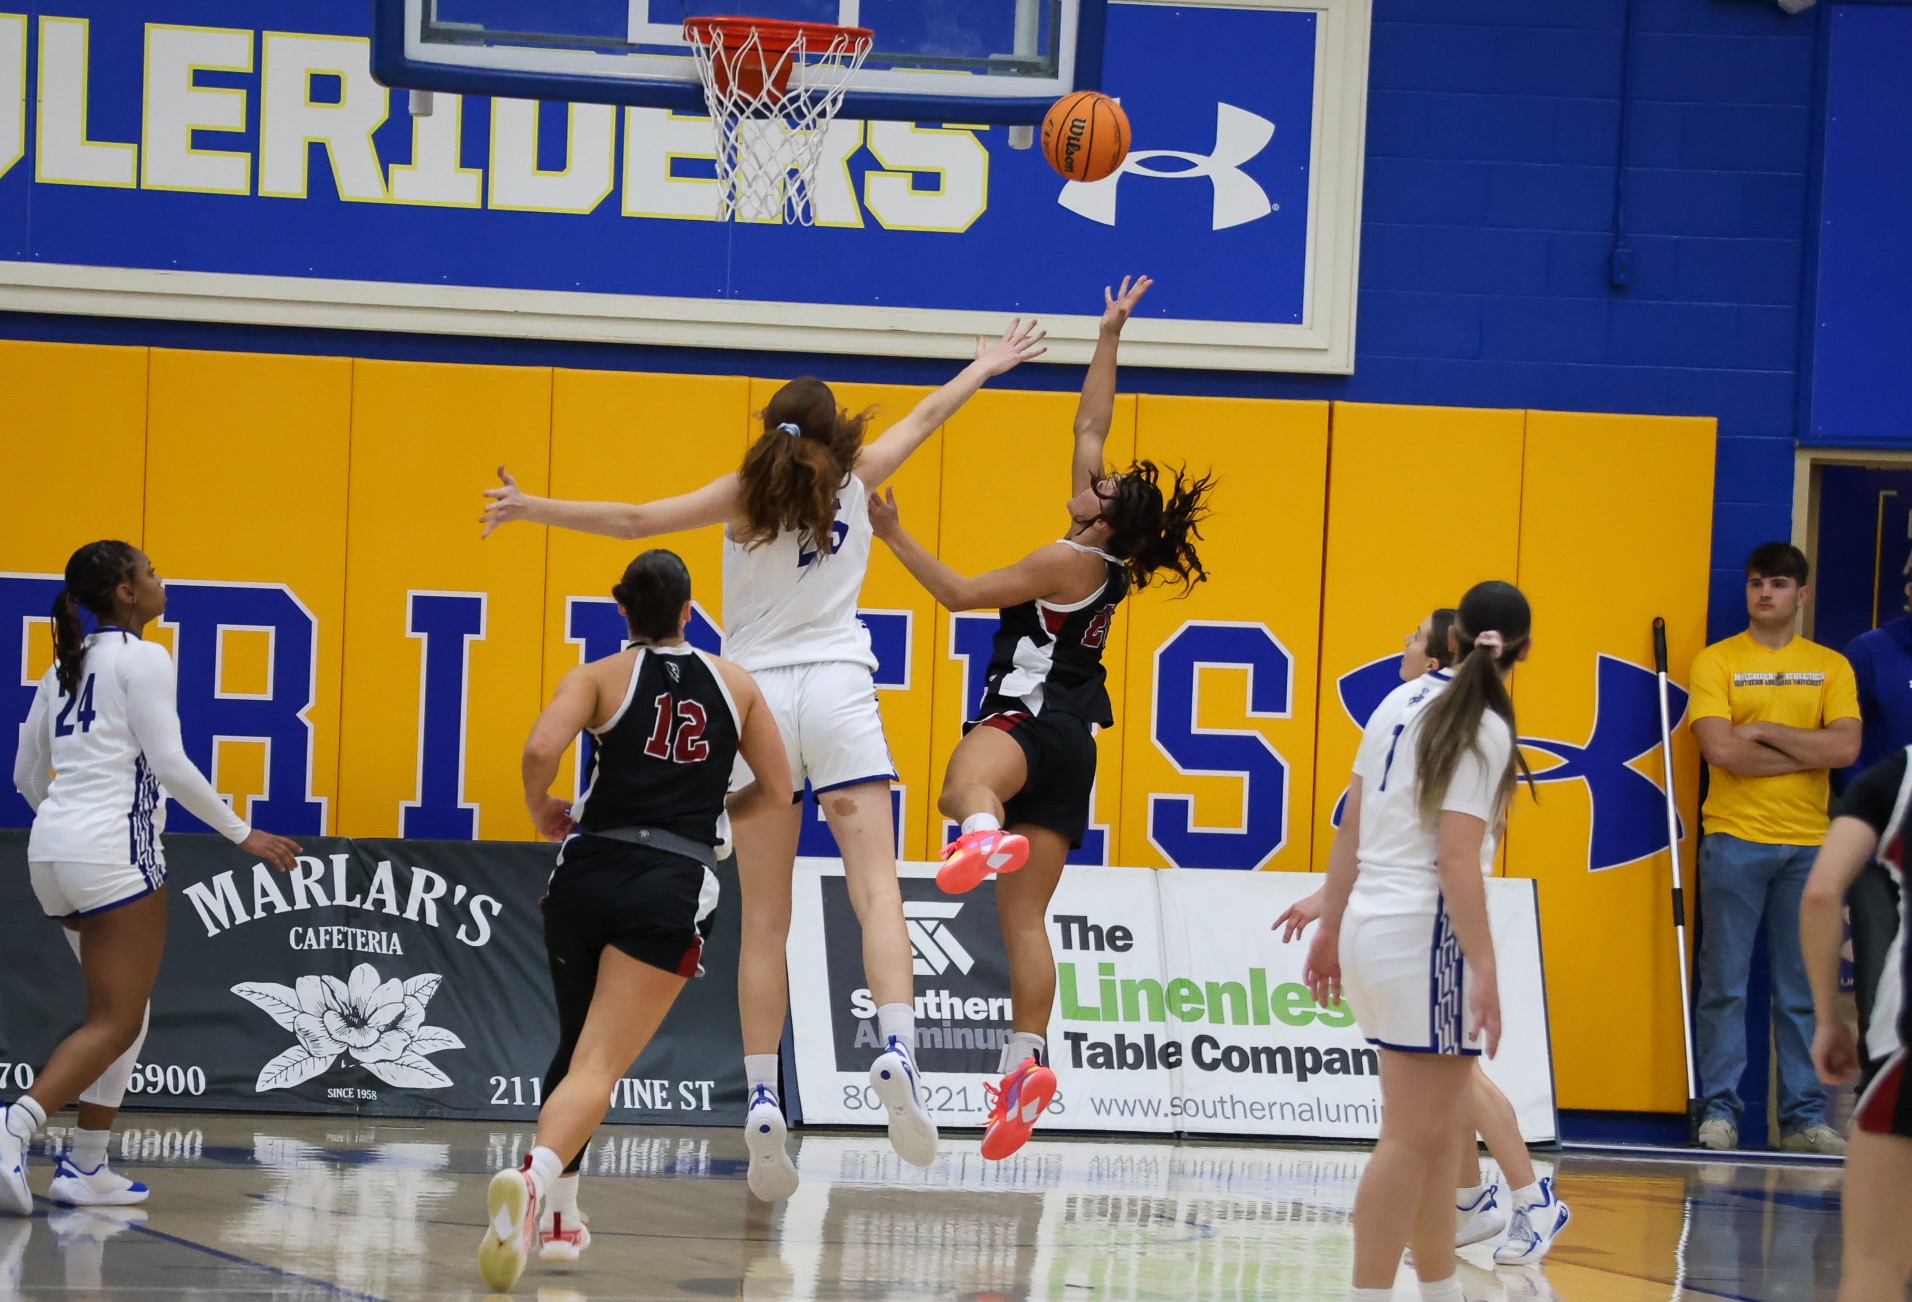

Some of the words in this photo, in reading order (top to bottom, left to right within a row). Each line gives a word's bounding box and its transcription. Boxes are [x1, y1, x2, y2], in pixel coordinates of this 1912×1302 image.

[0, 13, 989, 233] LERIDERS
[1064, 117, 1088, 173] Wilson
[54, 672, 96, 737] 24
[643, 691, 710, 764] 12
[182, 853, 503, 947] MARLAR'S
[289, 926, 404, 955] CAFETERIA
[1053, 914, 1134, 953] The
[1057, 962, 1358, 1028] Linenles
[126, 1063, 206, 1096] 6900
[1063, 1031, 1183, 1070] Table
[1191, 1034, 1380, 1083] Compan
[327, 1087, 355, 1099] SINCE
[356, 1088, 378, 1101] 1958
[678, 1080, 715, 1111] ST
[1089, 1094, 1384, 1124] www.southernalumi
